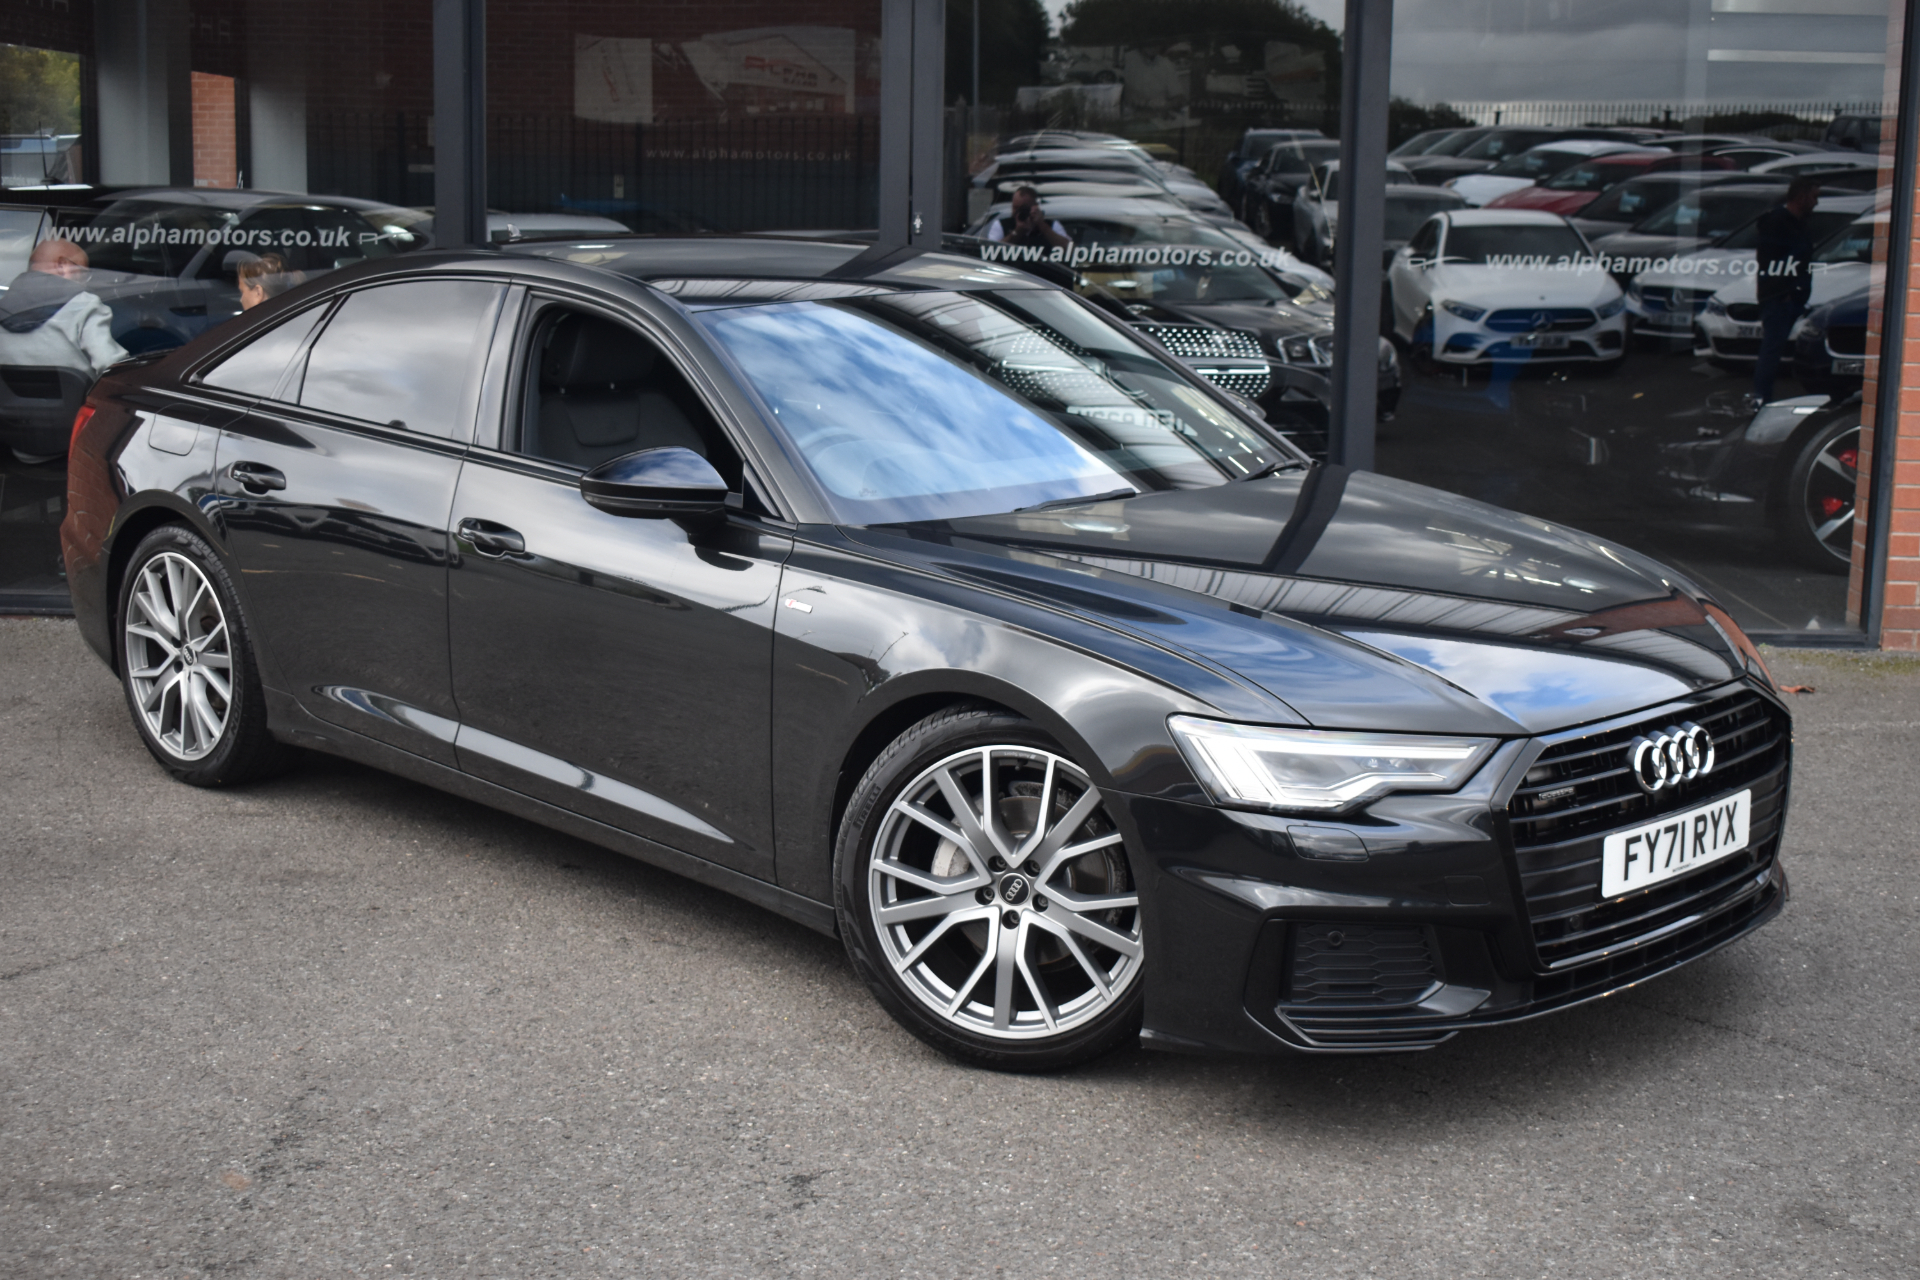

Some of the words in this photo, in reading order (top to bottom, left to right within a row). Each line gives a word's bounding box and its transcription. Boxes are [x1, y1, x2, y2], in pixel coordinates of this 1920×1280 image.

[646, 147, 851, 162] www.alphamotors.co.uk
[44, 223, 350, 249] www.alphamotors.co.uk
[981, 241, 1291, 268] www.alphamotors.co.uk
[1486, 251, 1800, 276] www.alphamotors.co.uk
